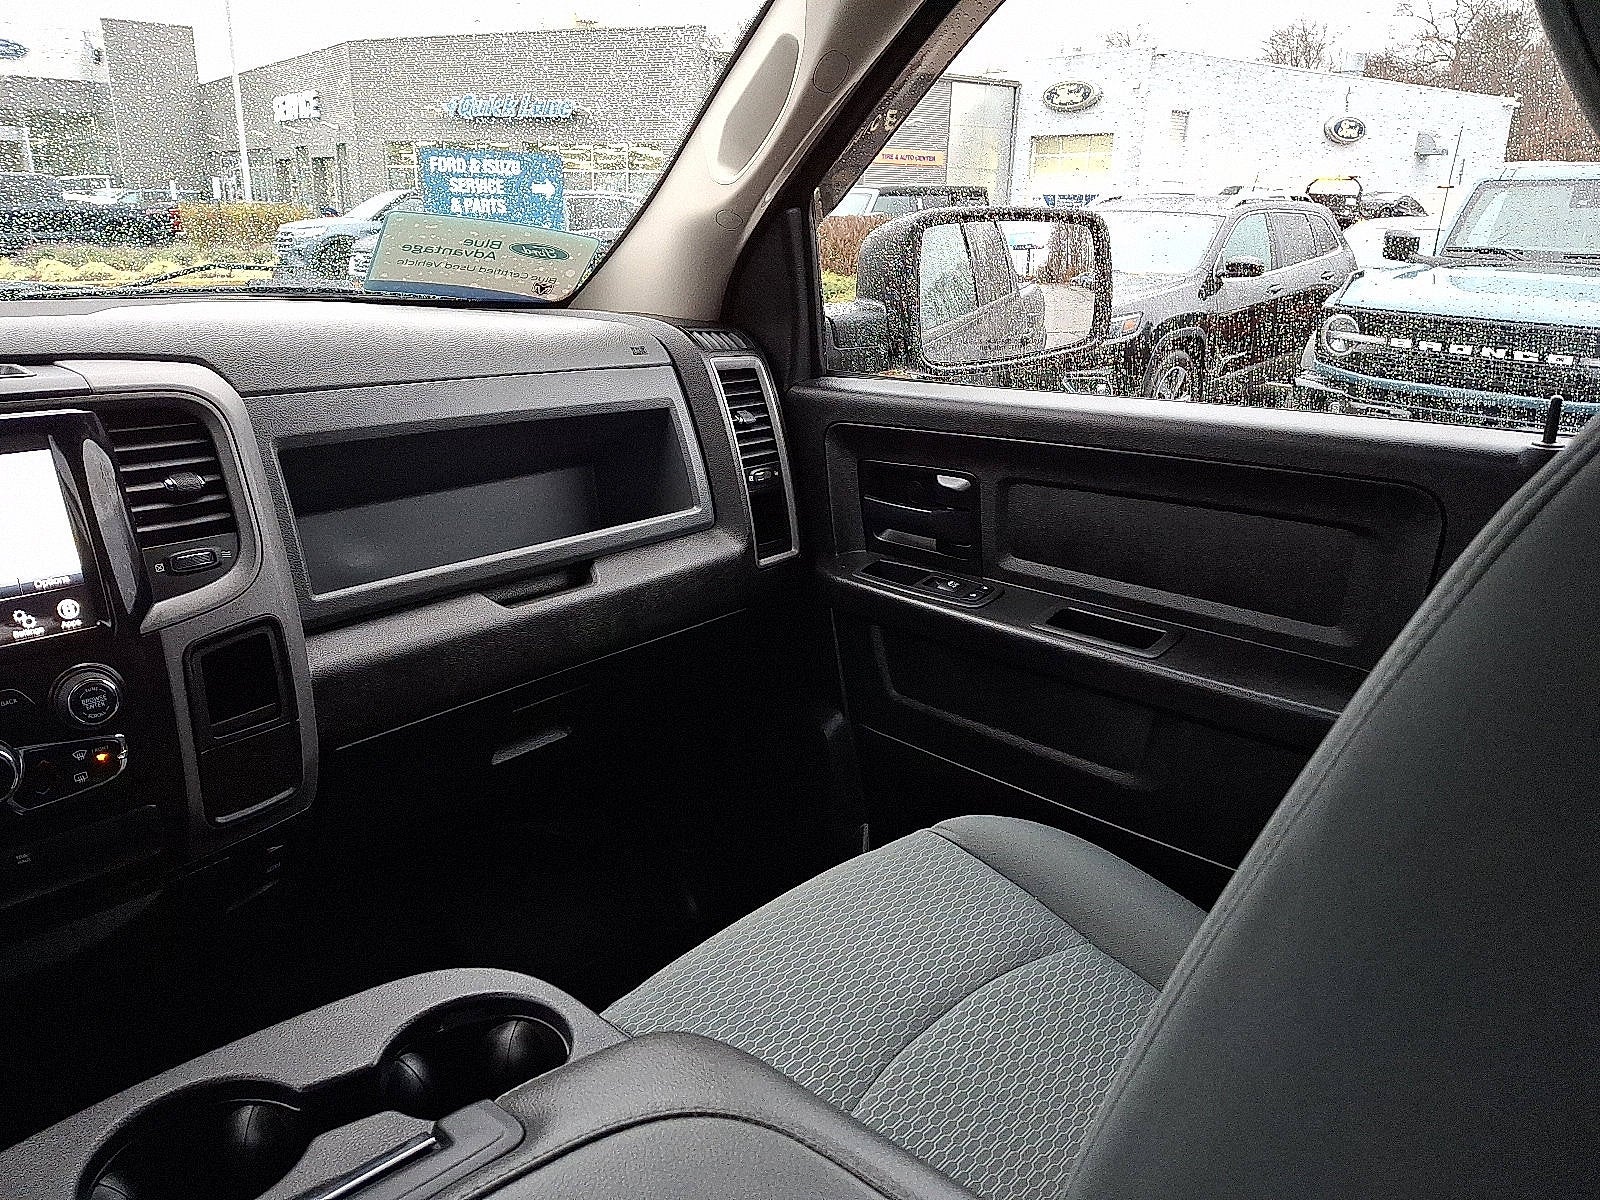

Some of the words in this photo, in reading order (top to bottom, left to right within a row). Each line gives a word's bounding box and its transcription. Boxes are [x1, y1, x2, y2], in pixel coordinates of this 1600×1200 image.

[428, 156, 467, 173] FORD
[468, 157, 480, 174] &
[481, 158, 522, 176] ISUZU
[450, 177, 505, 195] SERVICE
[450, 197, 462, 213] &
[463, 197, 507, 214] PARTS
[1390, 337, 1574, 366] BRONCO
[33, 575, 71, 590] Options
